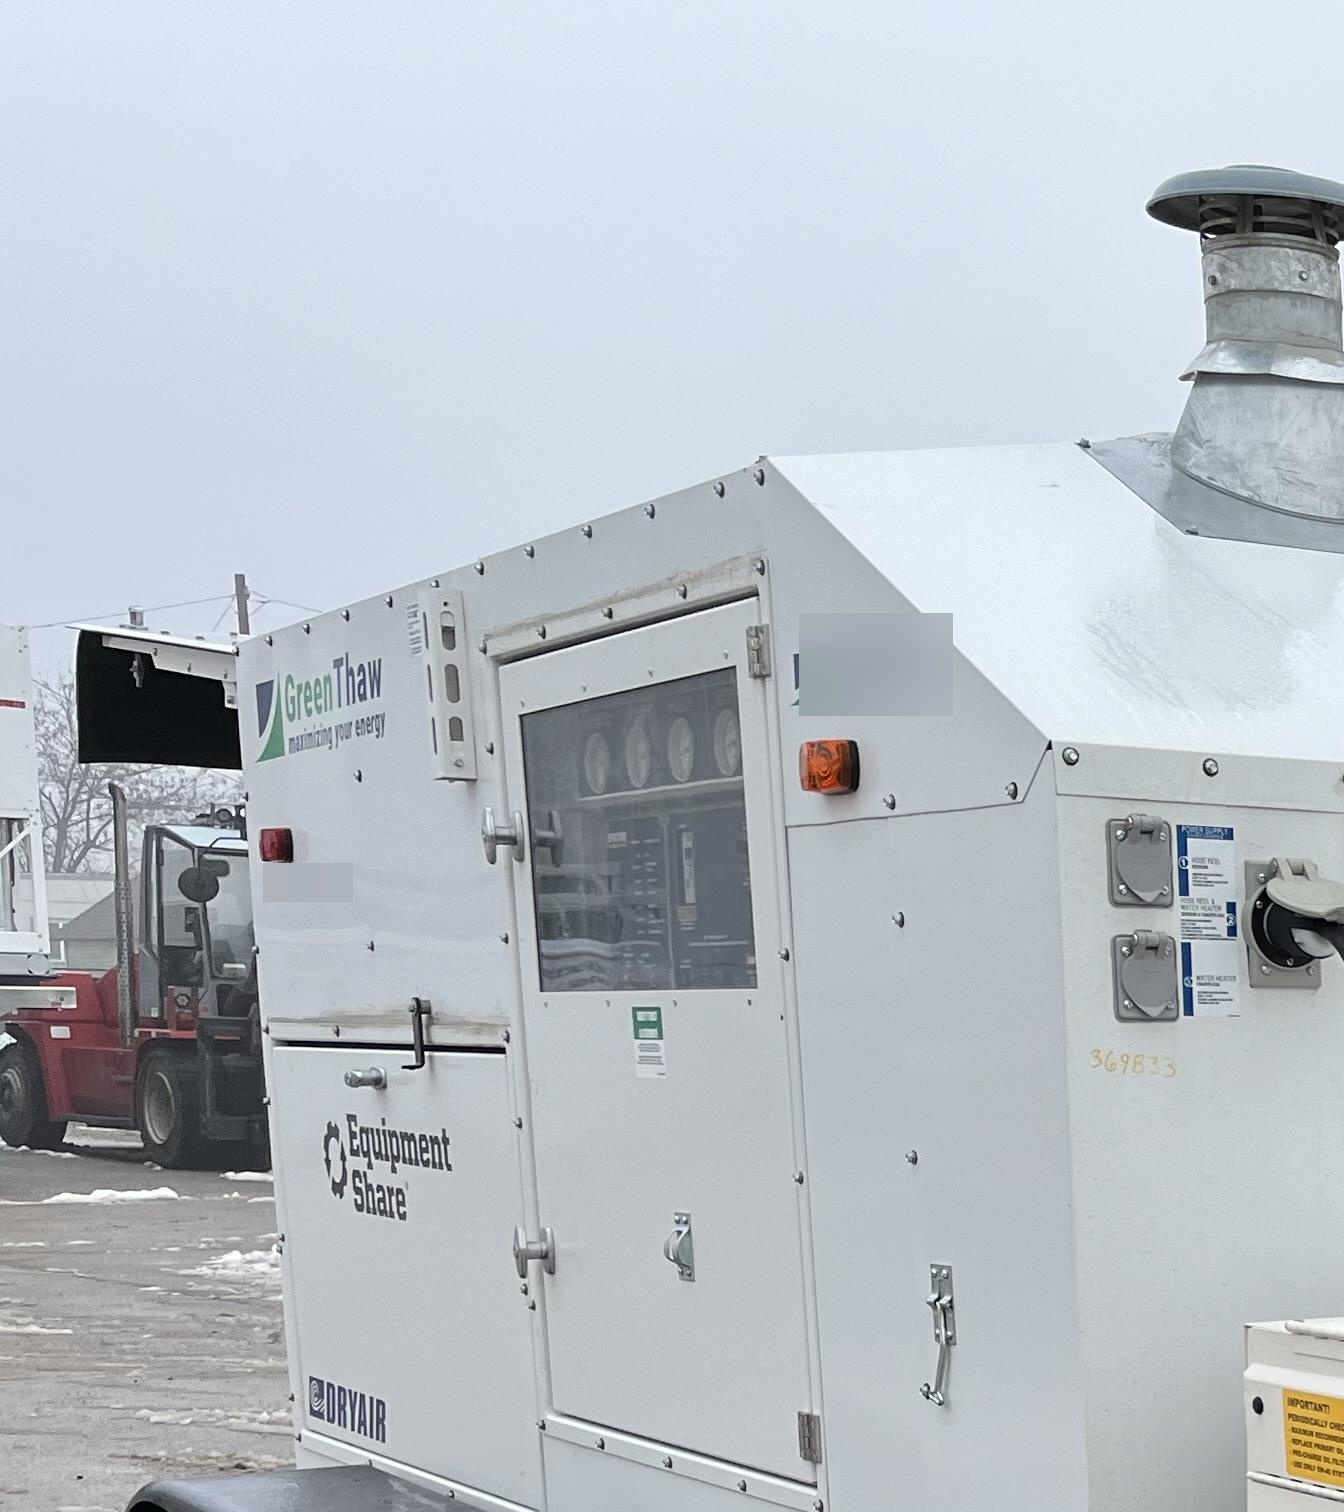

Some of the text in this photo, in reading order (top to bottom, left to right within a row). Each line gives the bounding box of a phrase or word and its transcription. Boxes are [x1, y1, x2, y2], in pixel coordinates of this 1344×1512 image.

[285, 652, 382, 723] GreenThaw
[288, 712, 386, 751] maximizing your energy
[1090, 1048, 1178, 1078] 369833
[345, 1112, 453, 1174] Equipment
[351, 1168, 408, 1222] Share
[326, 1381, 386, 1444] DRYAIR
[1287, 1397, 1329, 1413] IMPORTANT!
[1288, 1414, 1327, 1428] PERIODICALLY
[1336, 1447, 1344, 1455] OIL
